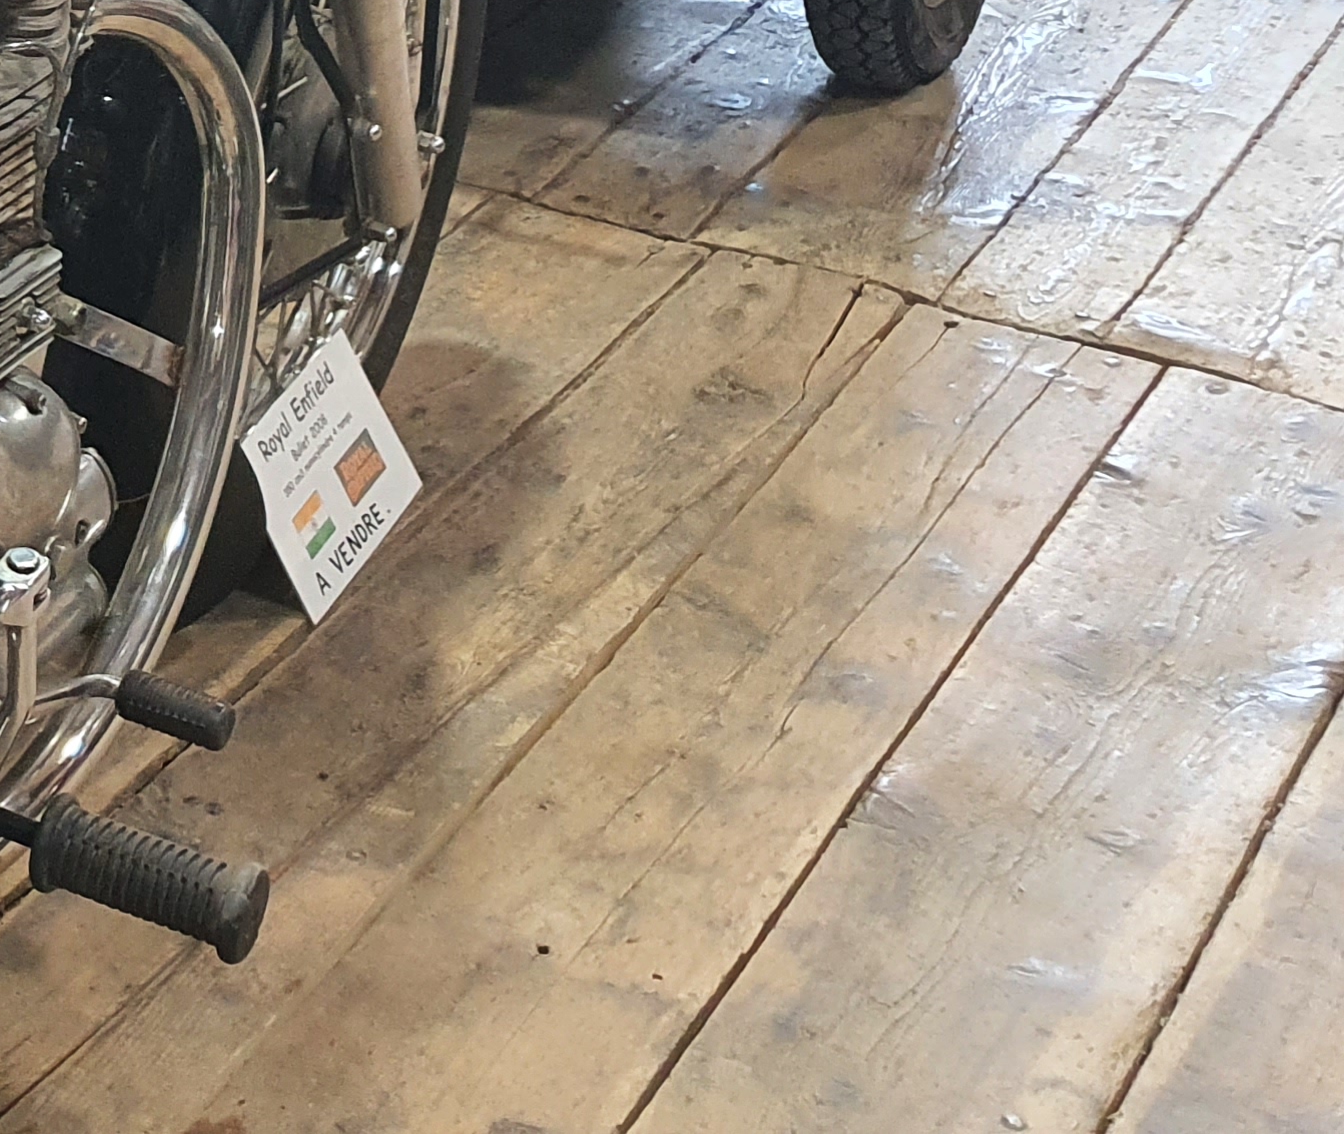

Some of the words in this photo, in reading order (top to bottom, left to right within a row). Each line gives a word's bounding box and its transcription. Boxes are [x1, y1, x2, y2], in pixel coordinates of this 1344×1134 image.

[257, 411, 293, 463] Royal
[289, 361, 335, 423] Enfield
[315, 571, 332, 597] A
